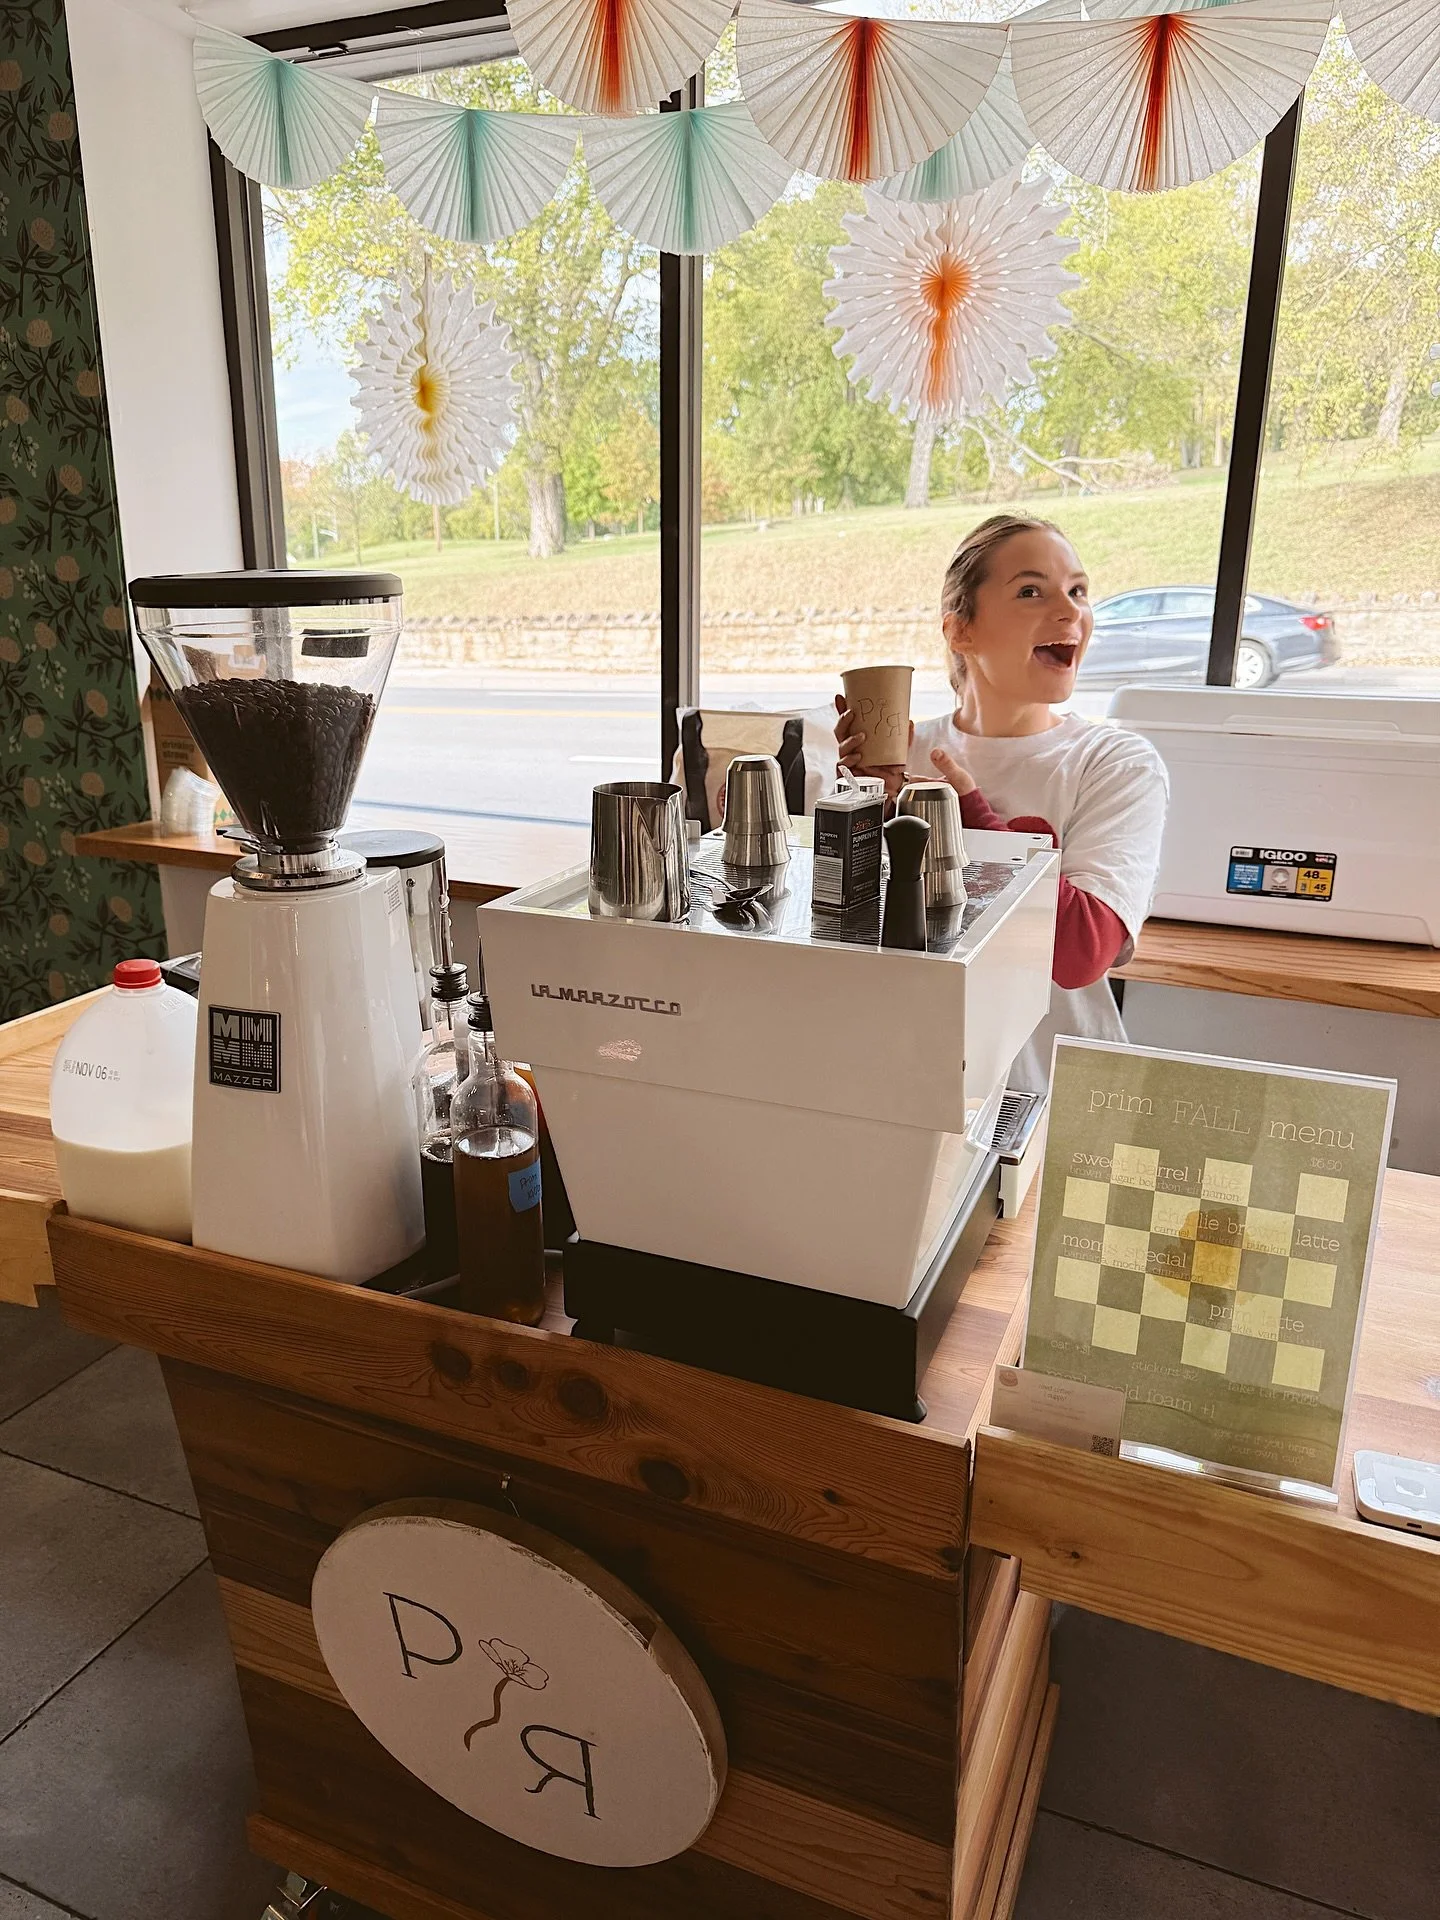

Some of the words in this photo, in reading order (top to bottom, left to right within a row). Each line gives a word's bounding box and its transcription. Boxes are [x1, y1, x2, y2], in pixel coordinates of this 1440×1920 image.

[1259, 849, 1307, 862] IGLOO
[1303, 870, 1320, 880] 48
[1313, 883, 1327, 891] 45
[75, 1061, 95, 1077] NOV
[95, 1065, 108, 1080] 06
[213, 1071, 273, 1088] MAZZER
[1087, 1089, 1154, 1116] prim
[1172, 1100, 1251, 1135] FALL
[1267, 1120, 1355, 1150] menu
[1072, 1152, 1130, 1172] sweet
[1136, 1158, 1189, 1182] barrel
[1196, 1168, 1242, 1190] latte
[1156, 1208, 1220, 1231] charlie
[1227, 1217, 1290, 1242] brown
[1294, 1229, 1341, 1252] latte
[1124, 1245, 1187, 1269] special
[1194, 1255, 1238, 1275] latte
[1208, 1303, 1252, 1322] prim
[1261, 1310, 1305, 1332] latte
[1146, 1390, 1193, 1413] foam
[382, 1591, 464, 1681] P
